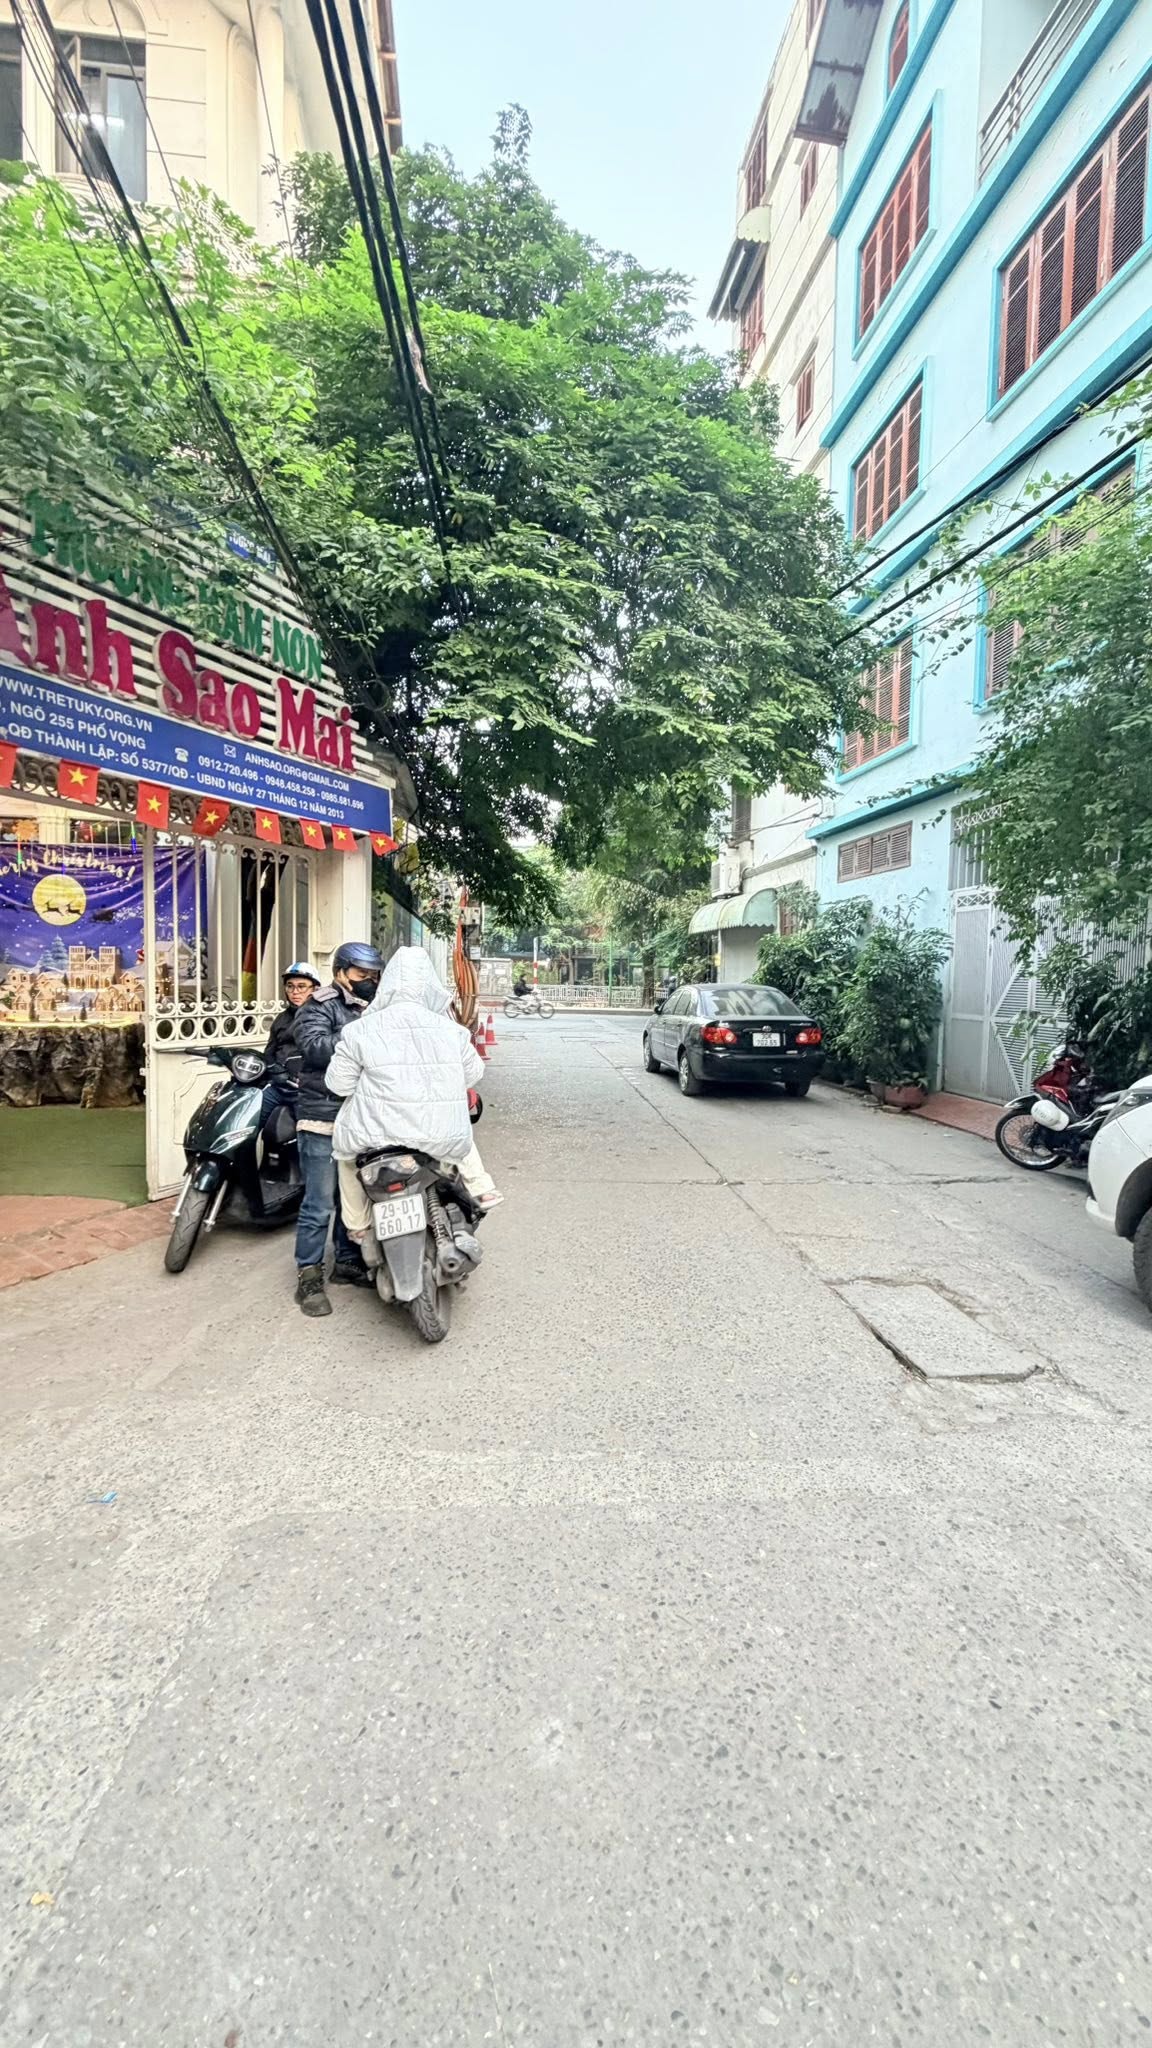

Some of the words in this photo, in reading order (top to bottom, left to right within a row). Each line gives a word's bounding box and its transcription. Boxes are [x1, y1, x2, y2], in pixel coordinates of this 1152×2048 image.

[272, 616, 322, 682] NON
[0, 675, 153, 733] WW.TRETUKY.ORG.VN
[10, 700, 46, 722] NGÕ
[49, 712, 75, 730] 255
[78, 720, 107, 739] PHỐ
[108, 729, 147, 750] VỌNG
[154, 630, 261, 741] Sao
[274, 677, 356, 772] Mai
[8, 722, 32, 740] QĐ
[34, 728, 86, 754] THÀNH
[89, 744, 119, 762] LẬP:
[121, 751, 140, 767] SỐ
[141, 758, 188, 779] 5377/QĐ
[197, 771, 226, 789] UBND
[228, 780, 255, 797] NGÀY
[255, 788, 266, 799] 27
[267, 792, 298, 808] THÁNG
[299, 800, 309, 811] 12
[309, 802, 327, 816] NĂM
[327, 809, 345, 820] 2013
[244, 752, 350, 792] ANHSAO.ORG@GMAIL.COM
[0, 858, 39, 876] erry
[379, 1213, 421, 1236] 660.17
